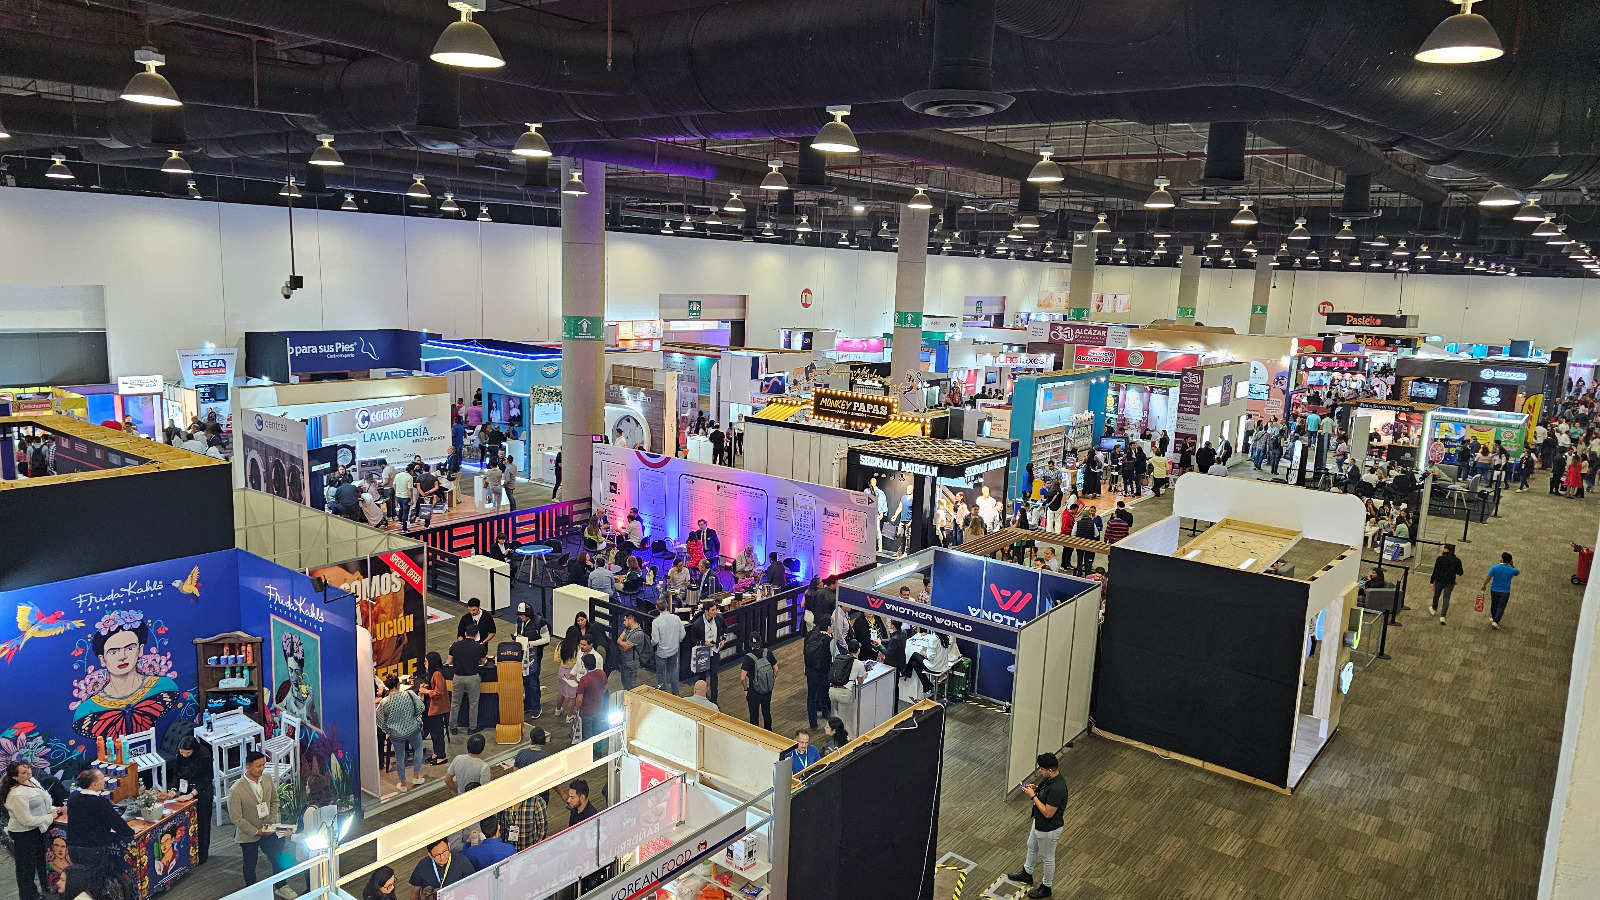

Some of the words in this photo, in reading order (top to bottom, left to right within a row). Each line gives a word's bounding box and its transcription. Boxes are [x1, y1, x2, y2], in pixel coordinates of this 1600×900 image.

[1346, 315, 1382, 326] Pasteko
[1354, 334, 1386, 347] asteko
[295, 344, 318, 356] para
[319, 344, 334, 353] sus
[193, 360, 226, 369] MEGA
[820, 397, 852, 410] MONKEY
[852, 401, 888, 415] PAPAS
[363, 425, 429, 443] LAVANDERÍA
[859, 453, 900, 471] SHERMAN
[901, 461, 939, 477] MORGAN
[389, 553, 407, 574] SPECIAL
[407, 567, 422, 584] OFFER
[934, 616, 973, 632] WORLD
[661, 849, 692, 877] FOOD
